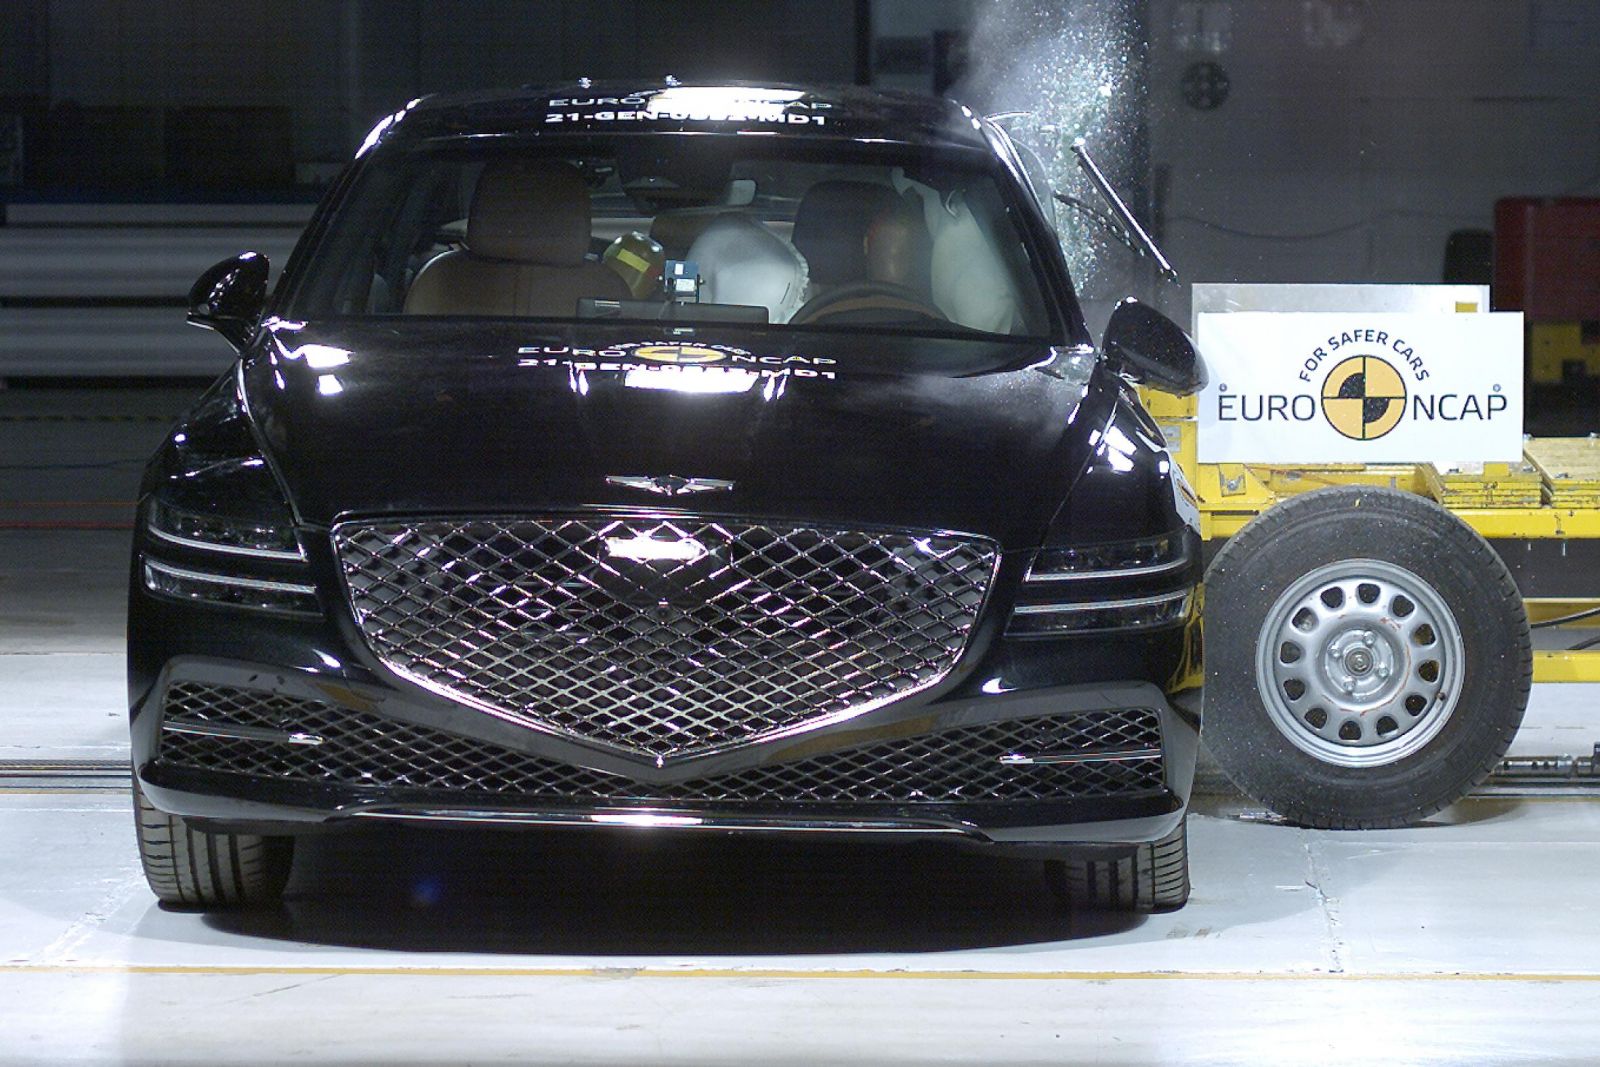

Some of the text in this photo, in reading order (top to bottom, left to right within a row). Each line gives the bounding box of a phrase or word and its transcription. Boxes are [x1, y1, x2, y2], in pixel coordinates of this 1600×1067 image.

[549, 97, 646, 106] EURO
[517, 347, 837, 365] EURO NCAP
[1299, 329, 1430, 382] FOR SAFER CARS
[1218, 394, 1508, 421] EURO NCAP
